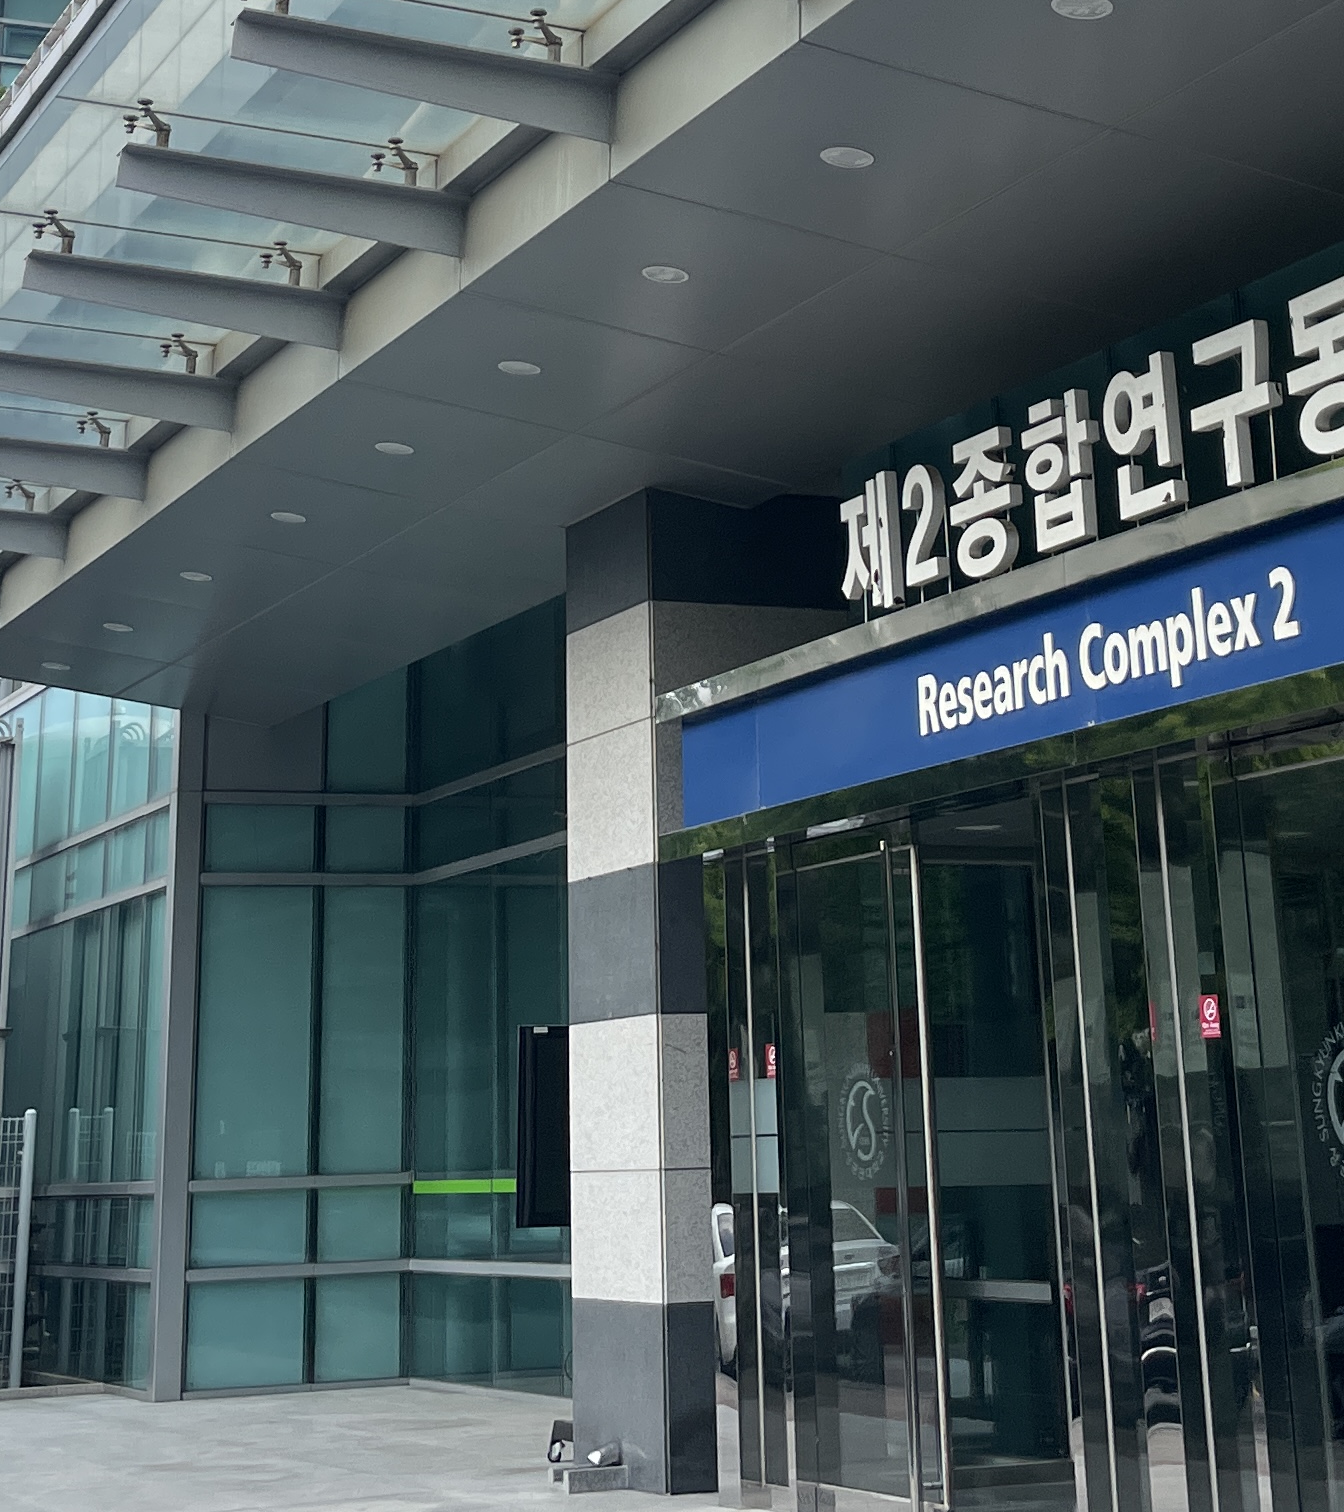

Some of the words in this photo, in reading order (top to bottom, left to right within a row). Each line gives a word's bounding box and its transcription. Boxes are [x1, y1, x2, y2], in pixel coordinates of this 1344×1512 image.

[917, 631, 1072, 737] Research
[1078, 585, 1262, 689] Complex
[1268, 565, 1302, 642] 2
